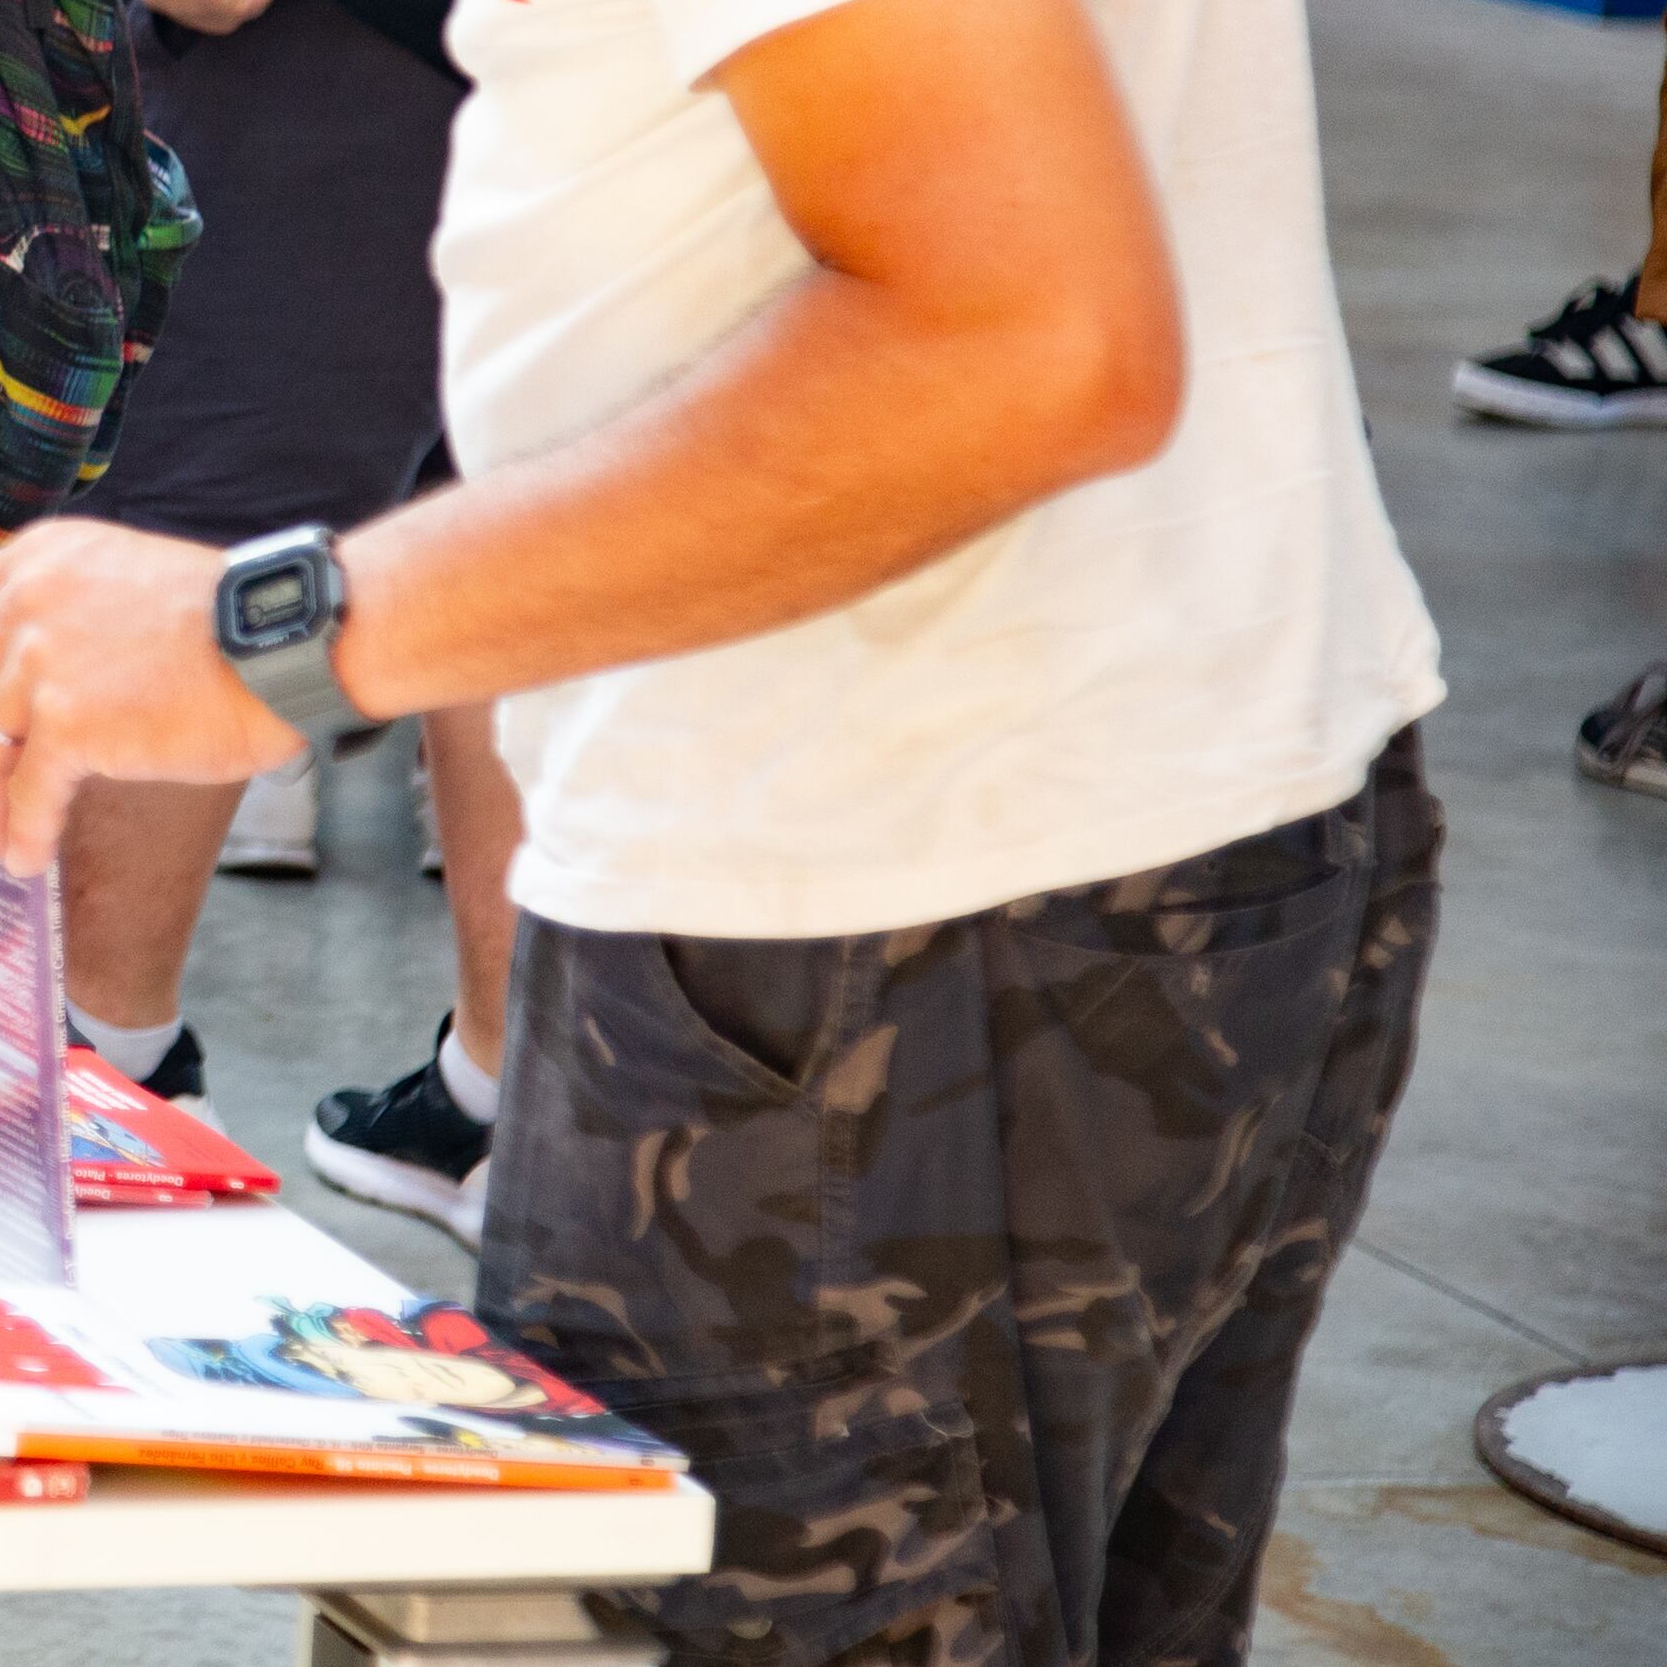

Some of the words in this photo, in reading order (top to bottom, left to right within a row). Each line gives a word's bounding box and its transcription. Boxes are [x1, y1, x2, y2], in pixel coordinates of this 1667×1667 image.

[52, 900, 63, 931] Trillo
[54, 934, 65, 970] Carlos
[56, 983, 67, 1024] Grimm
[74, 1169, 106, 1182] Plato
[116, 1172, 184, 1187] Doedytores
[304, 1455, 325, 1471] Ray
